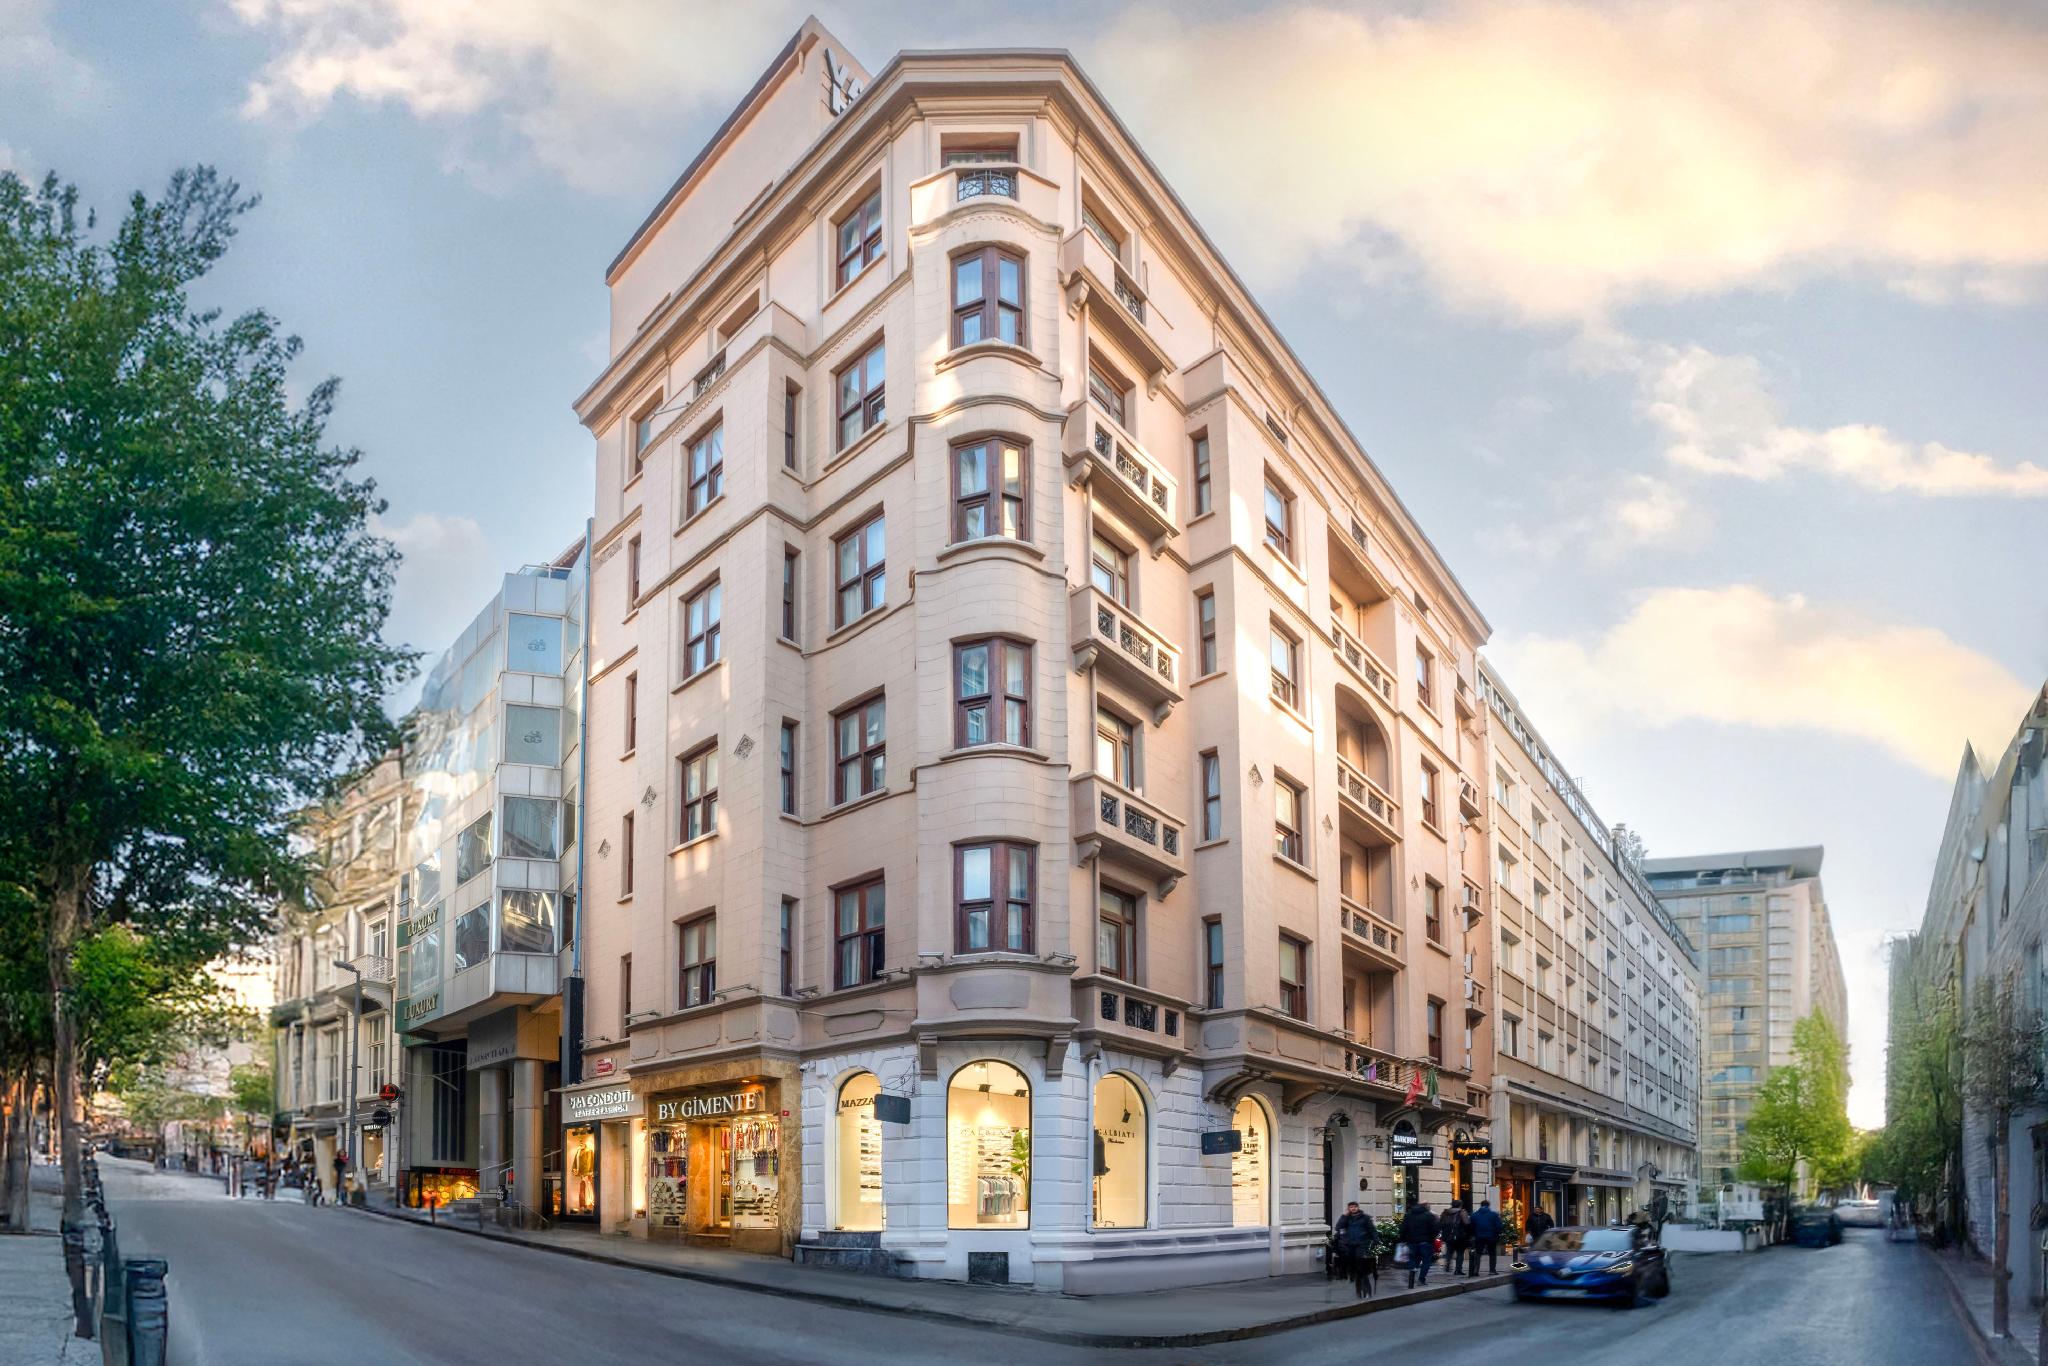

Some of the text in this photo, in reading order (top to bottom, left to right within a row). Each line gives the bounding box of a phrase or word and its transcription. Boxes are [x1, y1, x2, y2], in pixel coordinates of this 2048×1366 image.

[408, 907, 438, 937] LUXURY
[404, 992, 438, 1020] LUXURY
[658, 1092, 756, 1120] BY GİMENTE
